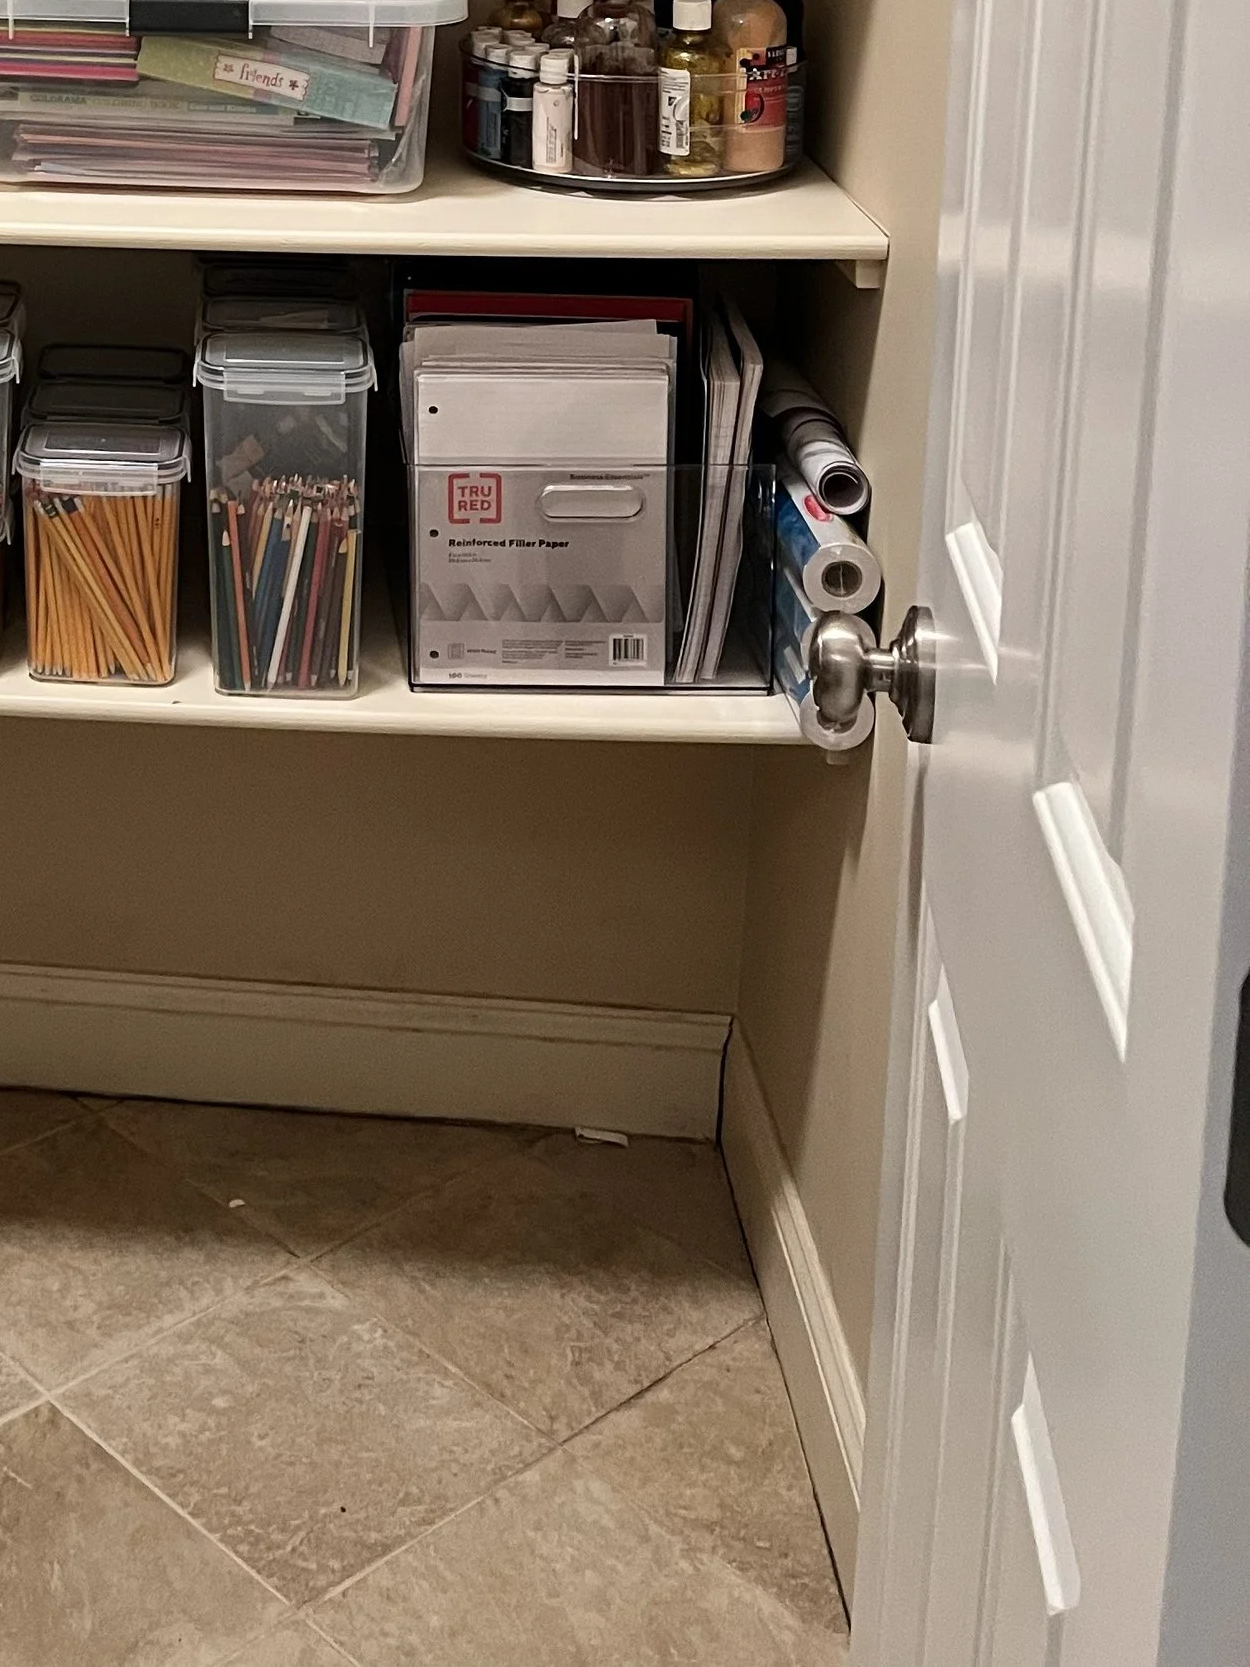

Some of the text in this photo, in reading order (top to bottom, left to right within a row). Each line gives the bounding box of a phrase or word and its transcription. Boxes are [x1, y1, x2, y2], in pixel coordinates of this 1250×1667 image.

[457, 485, 493, 498] TRU
[457, 499, 492, 512] RED
[448, 537, 570, 550] Reinforced Filler Paper
